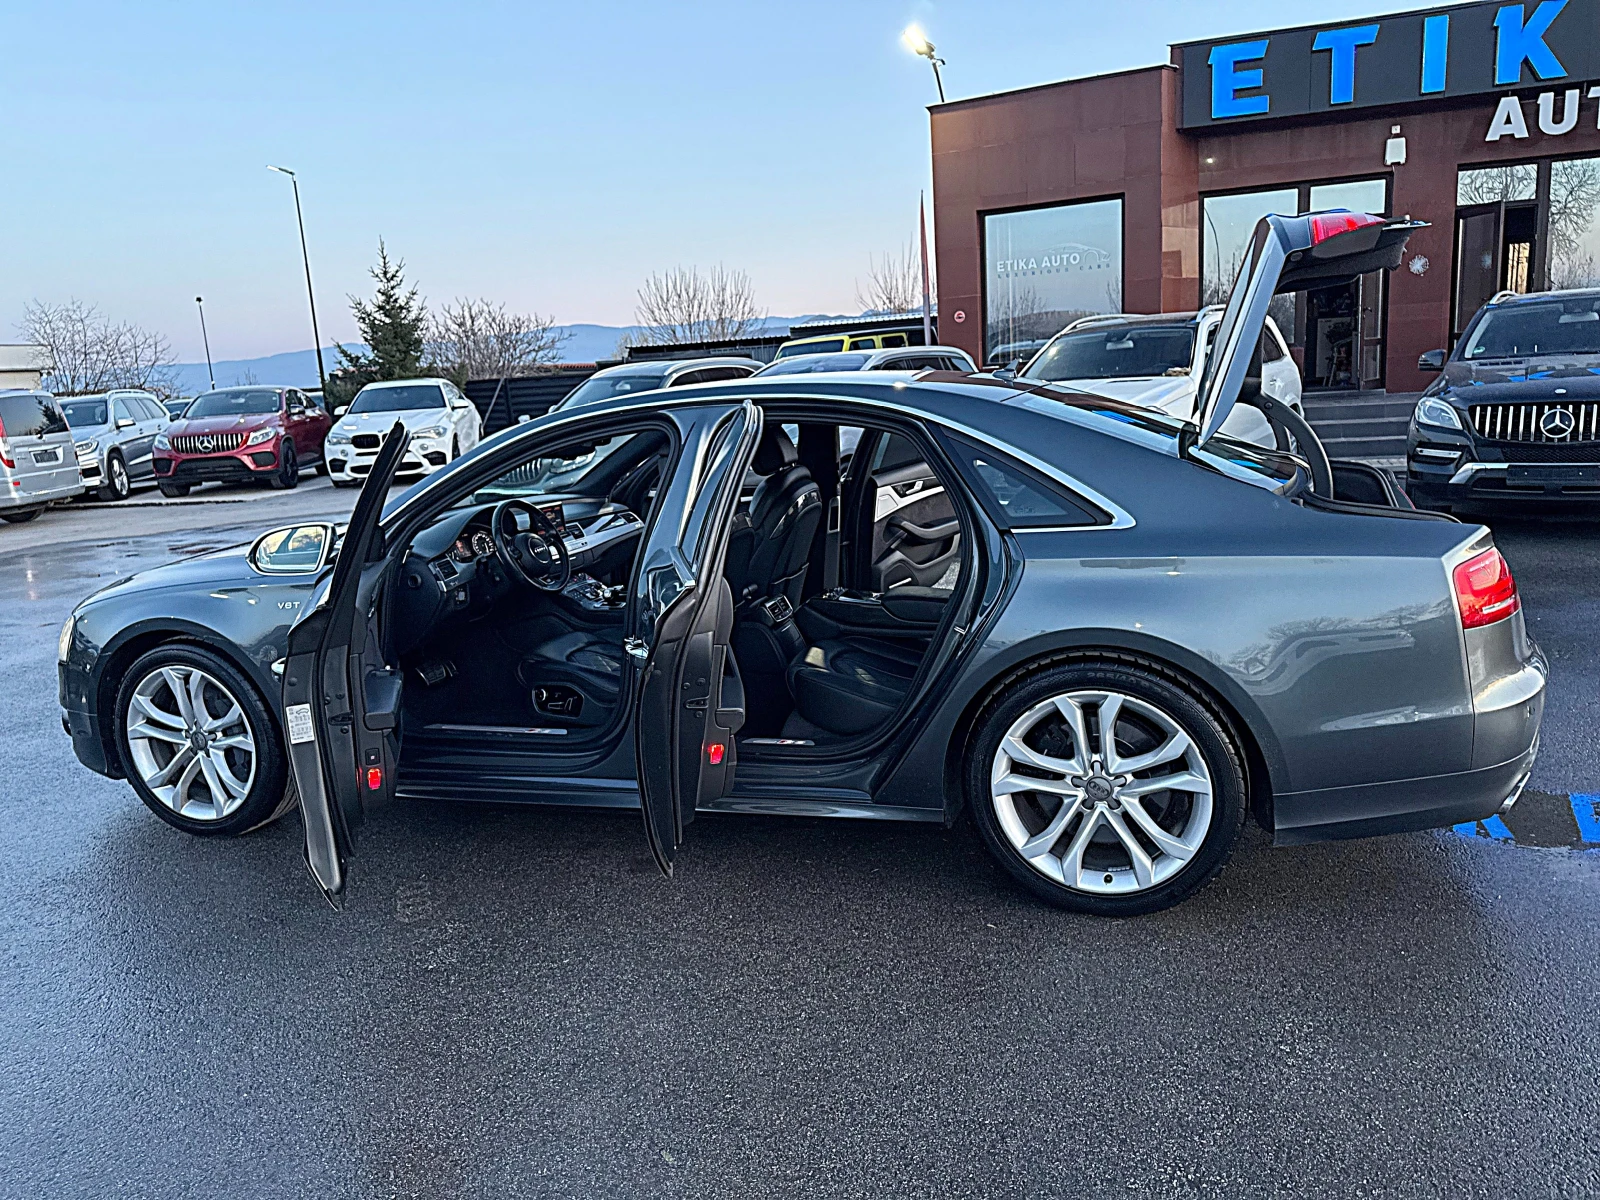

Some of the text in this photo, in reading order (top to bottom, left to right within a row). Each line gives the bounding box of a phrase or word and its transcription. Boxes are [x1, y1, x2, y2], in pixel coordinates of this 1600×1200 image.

[1208, 0, 1568, 119] ETIK
[996, 253, 1080, 272] ETIKA AUTO
[997, 263, 1110, 279] LUXURIOUS CARS
